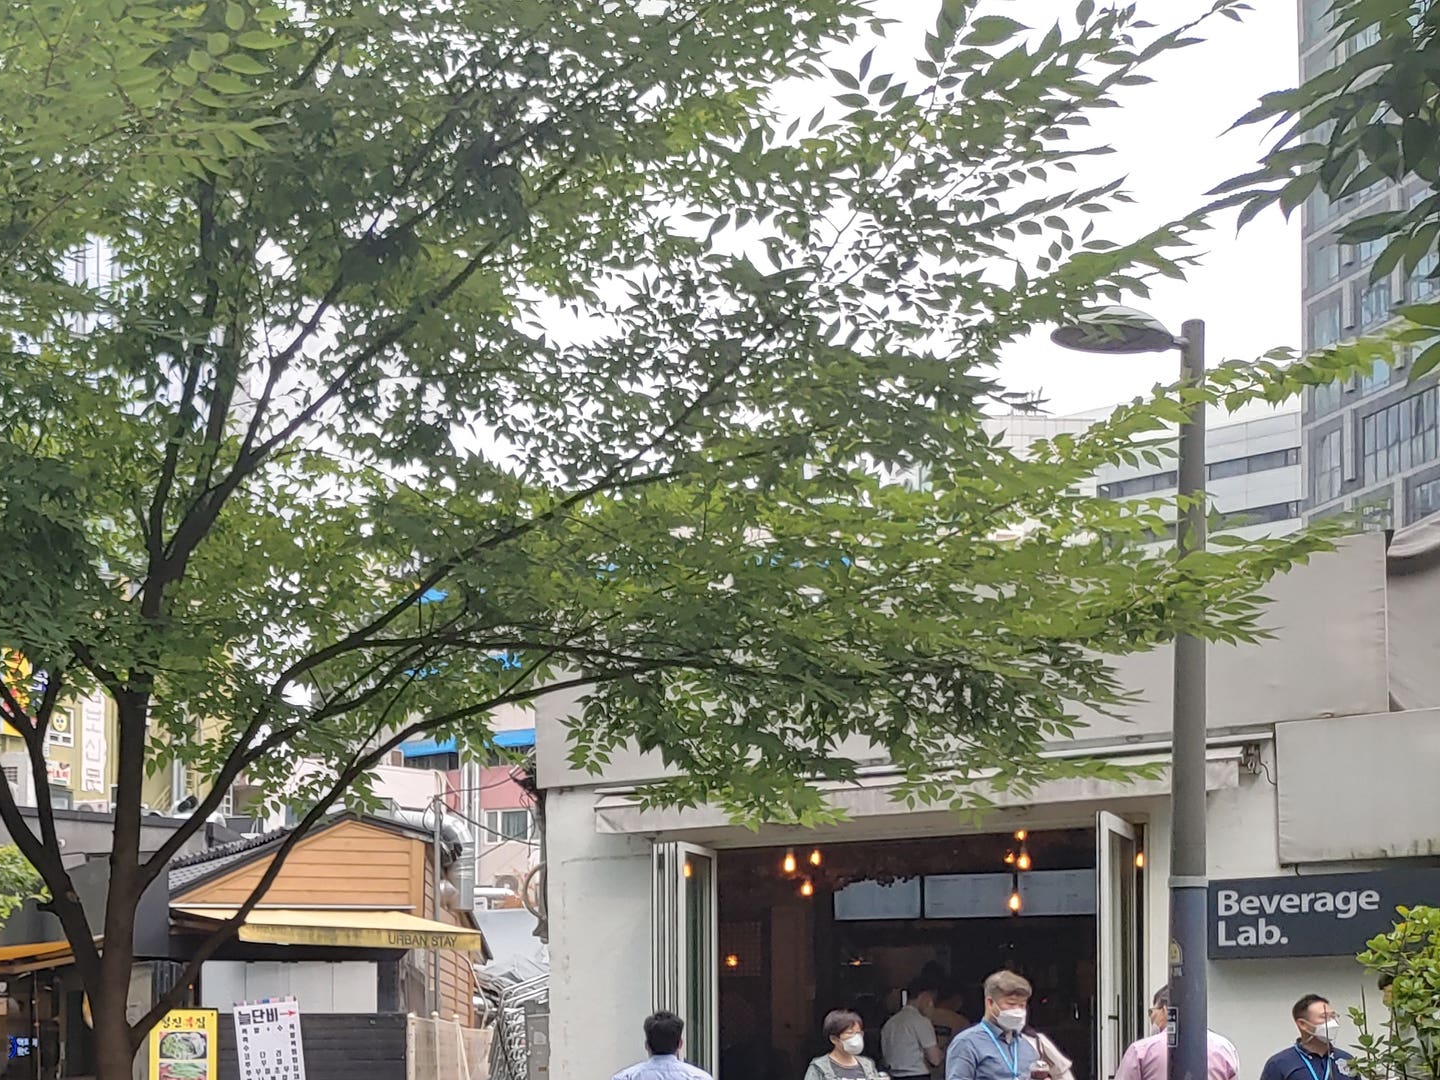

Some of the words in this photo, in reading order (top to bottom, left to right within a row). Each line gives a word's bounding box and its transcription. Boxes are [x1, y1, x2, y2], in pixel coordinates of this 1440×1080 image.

[1217, 889, 1380, 919] Beverage
[388, 934, 427, 946] URBAN
[431, 935, 457, 947] STAY
[1217, 918, 1289, 946] Lab.
[238, 1007, 279, 1025] 늘단비
